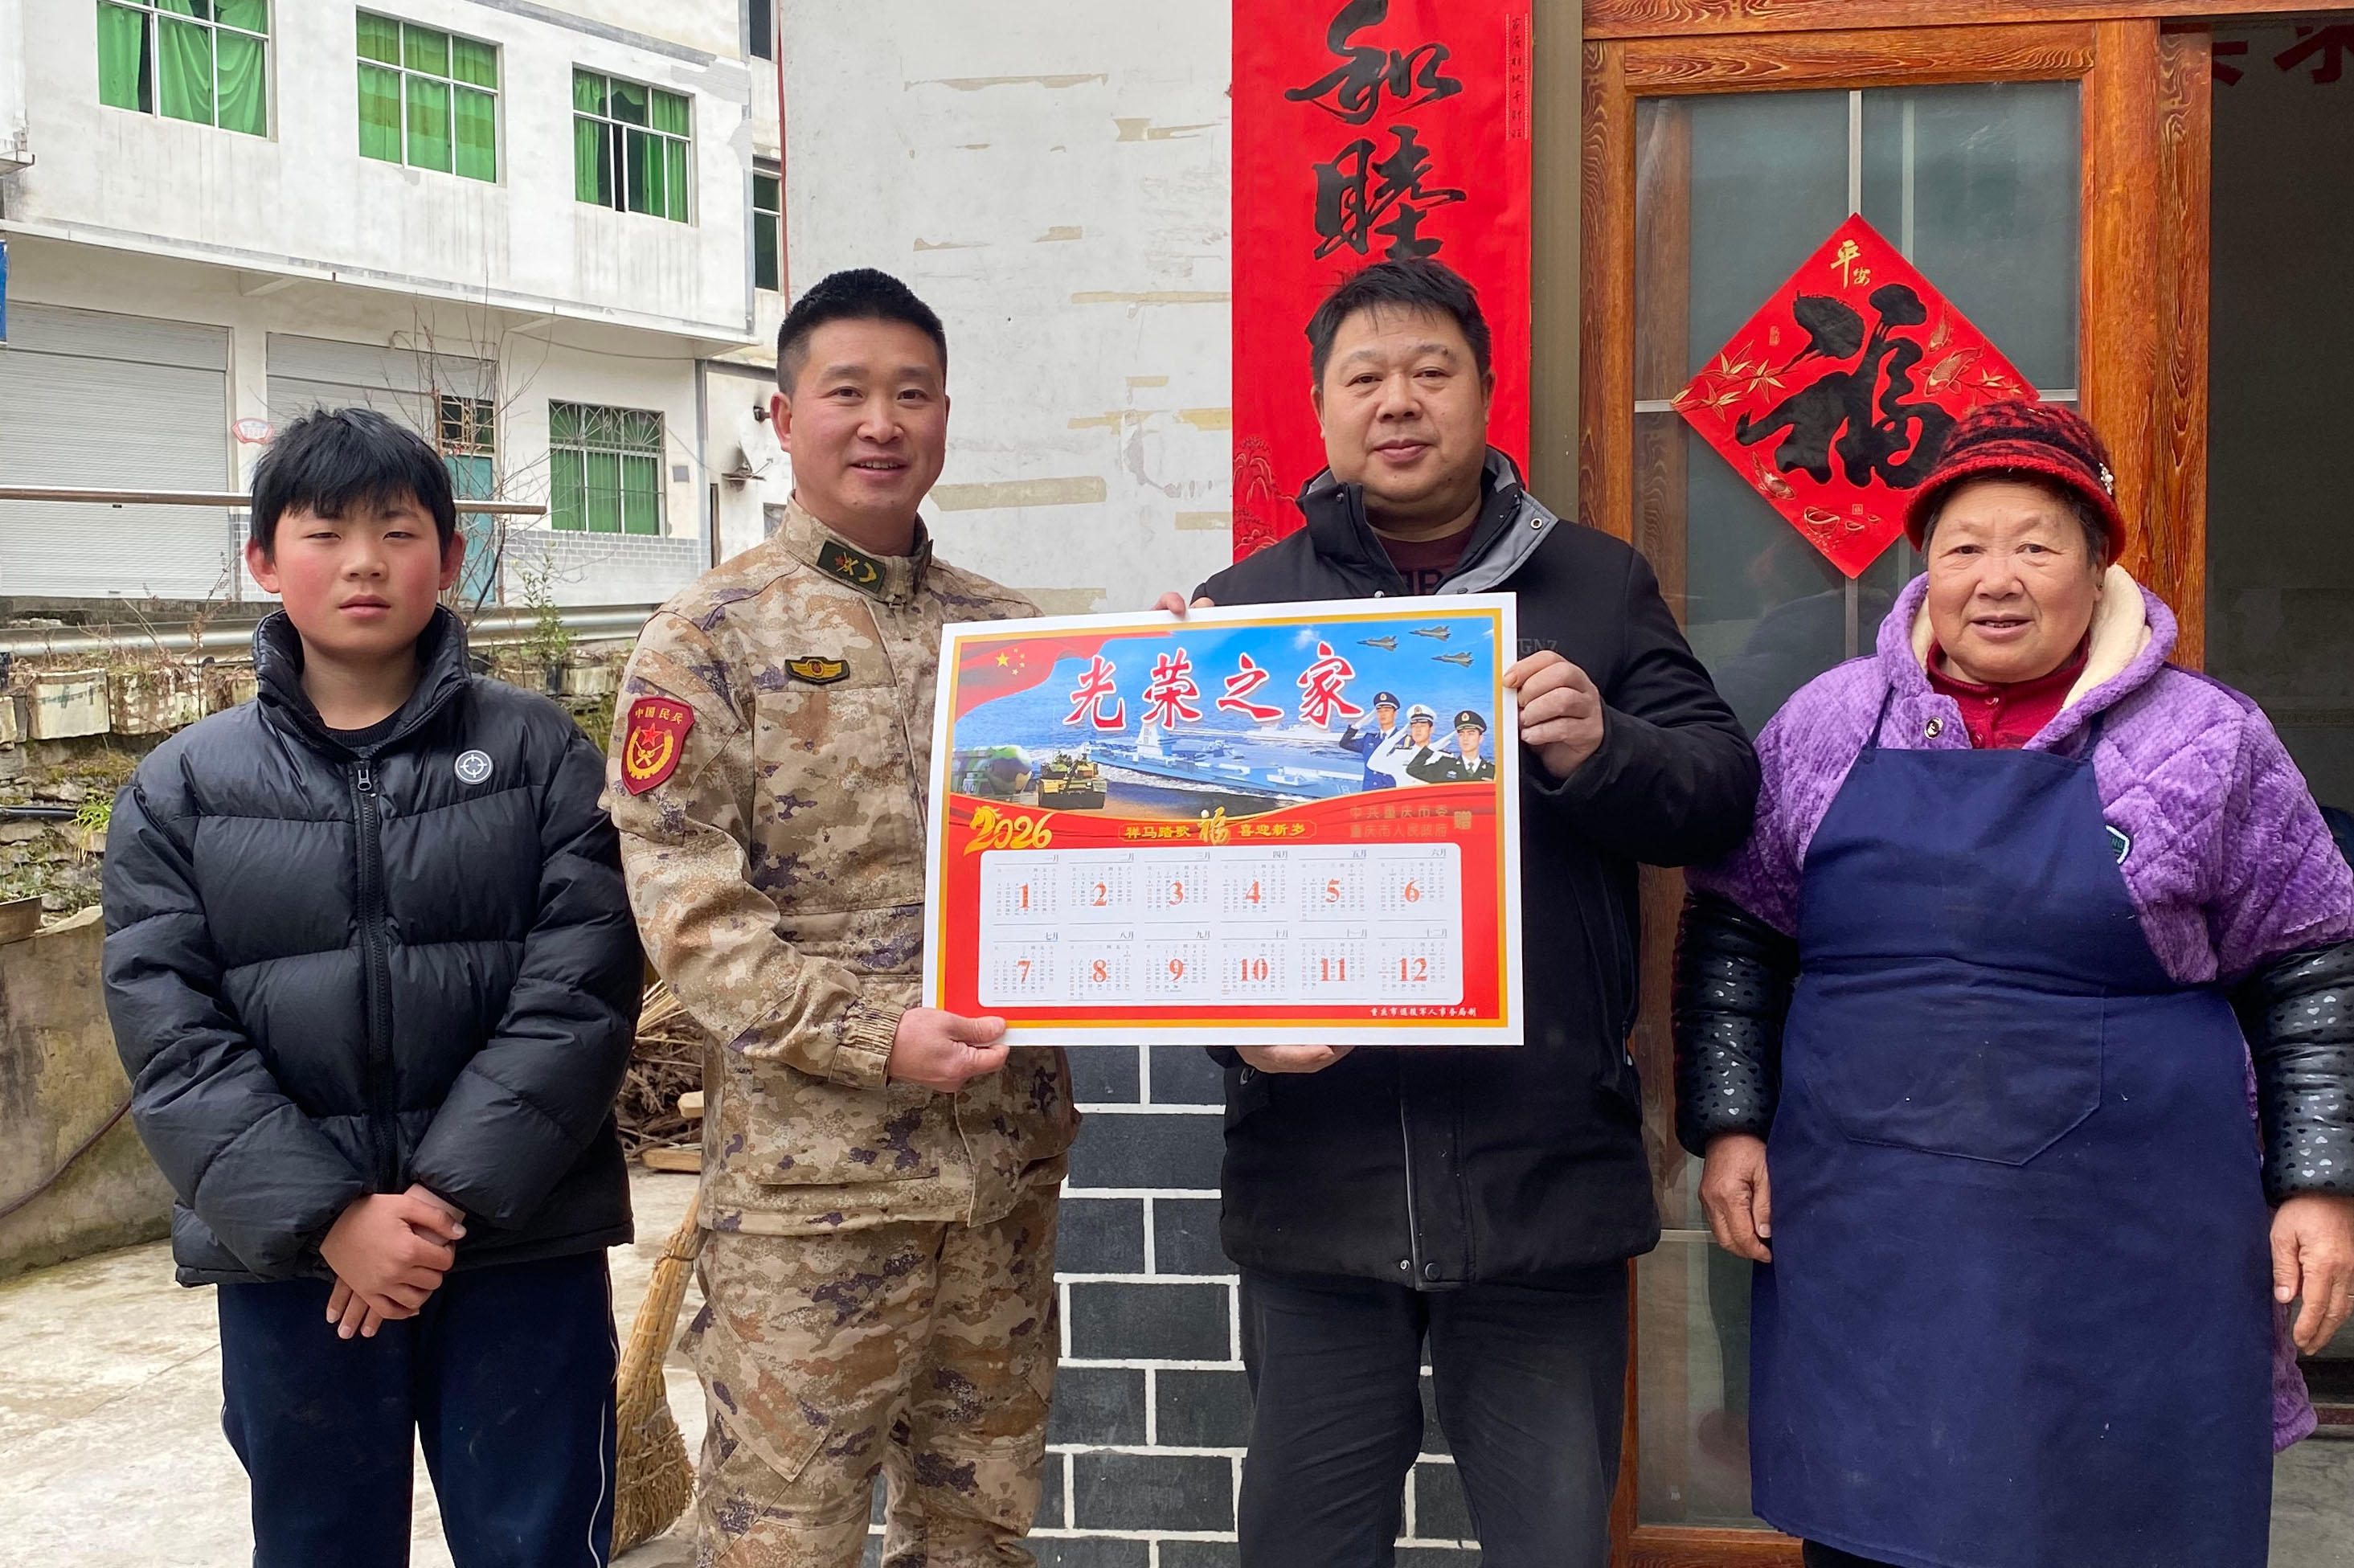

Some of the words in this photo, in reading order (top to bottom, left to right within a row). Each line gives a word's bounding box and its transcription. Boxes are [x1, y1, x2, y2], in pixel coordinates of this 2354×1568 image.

[1830, 239, 1872, 289] 平安
[1734, 283, 1958, 492] 福
[1062, 641, 1366, 732] 光荣之家
[635, 706, 683, 725] 中国民兵
[964, 804, 1053, 857] 2026
[1124, 825, 1192, 840] 祥马踏歌
[1197, 806, 1230, 845] 福
[1237, 822, 1306, 837] 喜迎新岁
[1350, 823, 1447, 838] 重庆市人民政府
[1454, 810, 1472, 829] 赠
[1018, 883, 1030, 910] 1
[1092, 882, 1107, 907] 2
[1169, 881, 1184, 906] 3
[1245, 881, 1261, 904] 4
[1325, 879, 1340, 903] 5
[1404, 879, 1419, 903] 6
[1017, 960, 1031, 985] 7
[1092, 959, 1107, 983] 8
[1169, 958, 1184, 982] 9
[1238, 957, 1268, 982] 10
[1319, 957, 1346, 982] 11
[1398, 957, 1428, 982] 12
